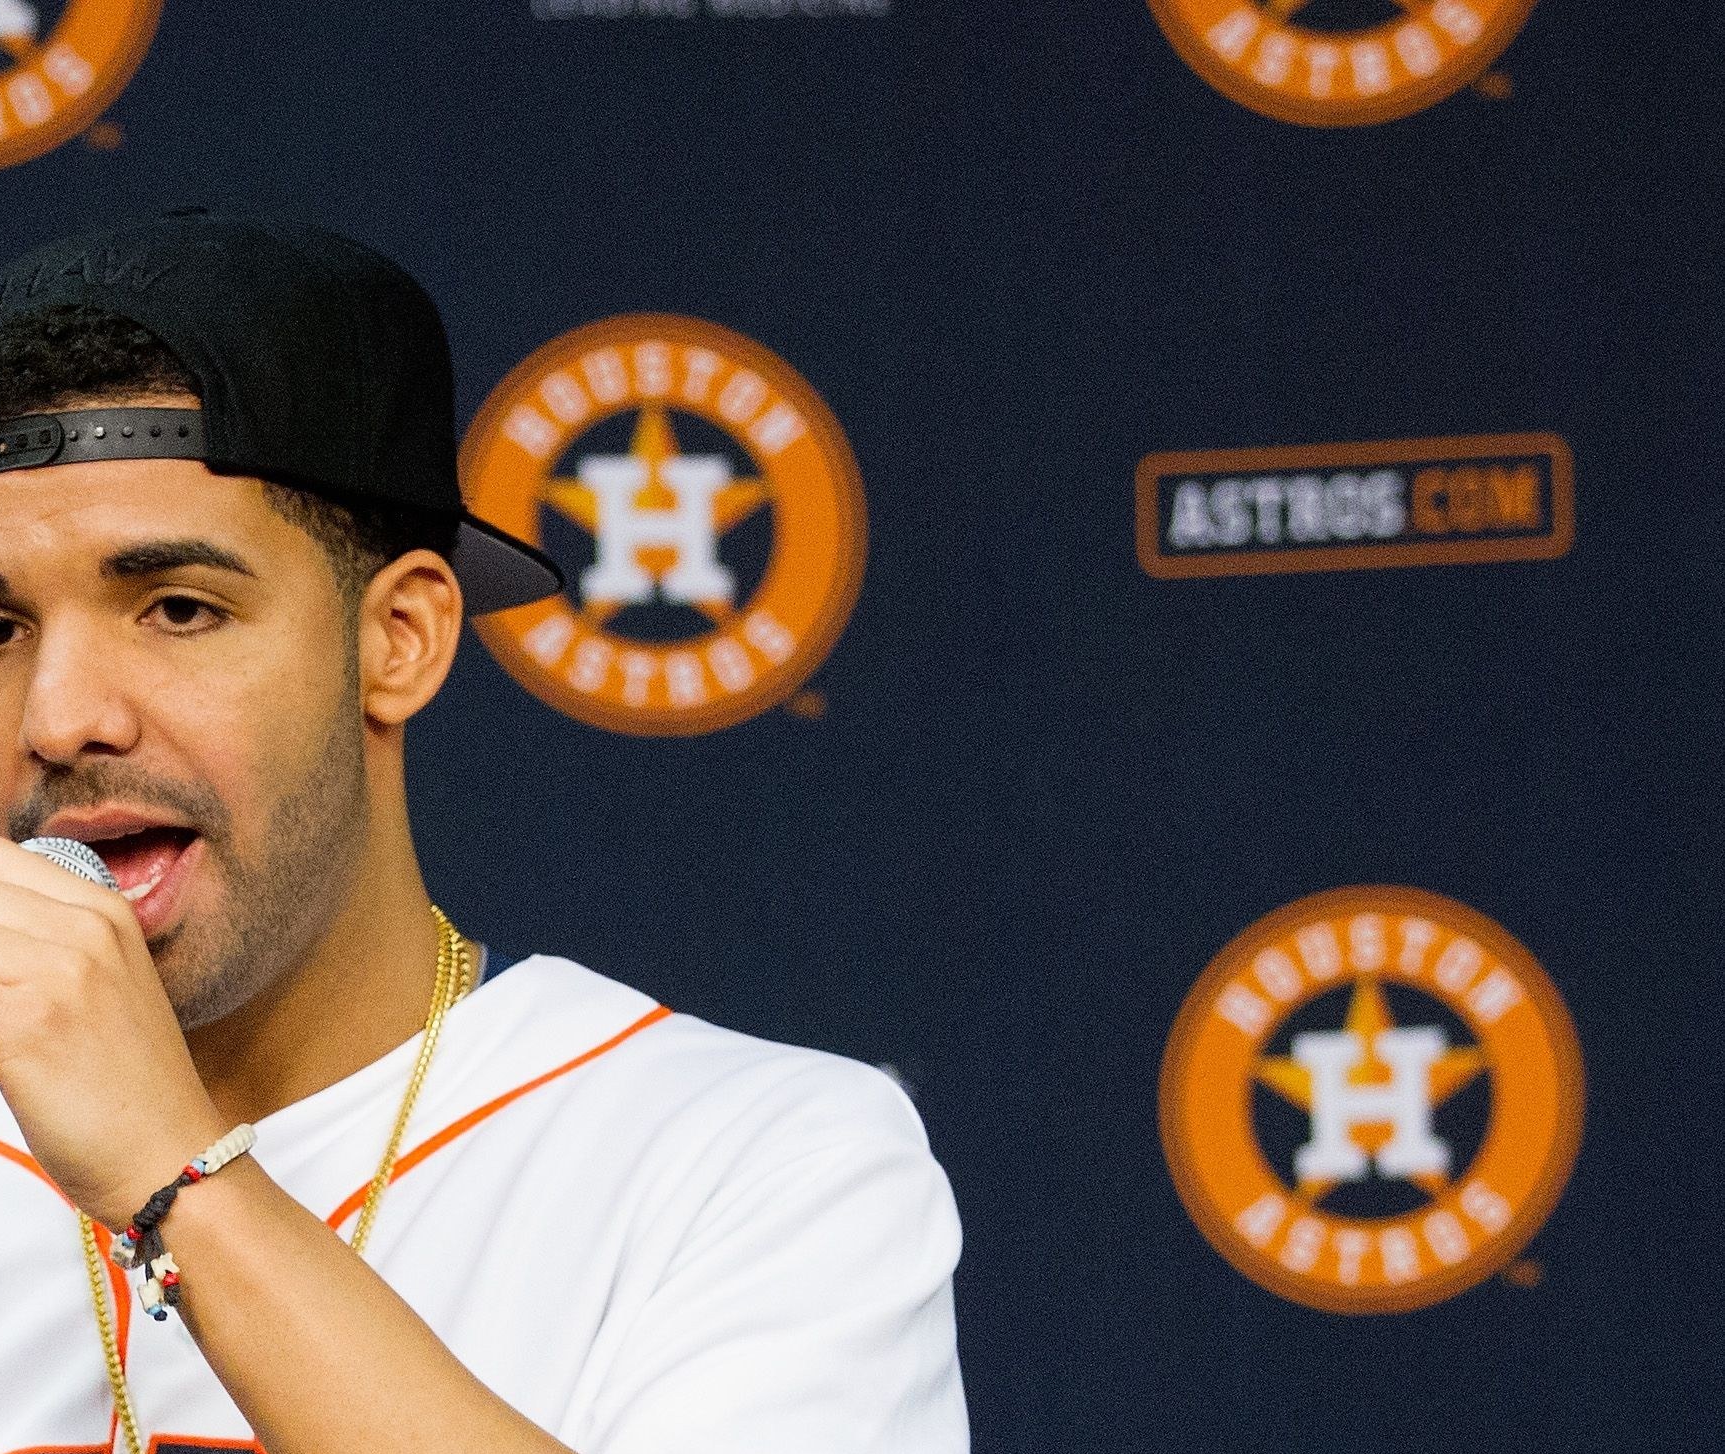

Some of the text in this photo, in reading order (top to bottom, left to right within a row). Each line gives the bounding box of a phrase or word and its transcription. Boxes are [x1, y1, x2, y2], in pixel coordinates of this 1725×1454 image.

[1206, 0, 1483, 99] ASTROS
[502, 340, 808, 458] HOUSTON
[578, 452, 736, 602] H
[523, 611, 797, 707] ASTROS
[1214, 913, 1525, 1038] HOUSTON
[1291, 1024, 1450, 1182] H
[1234, 1180, 1513, 1286] ASTROS
